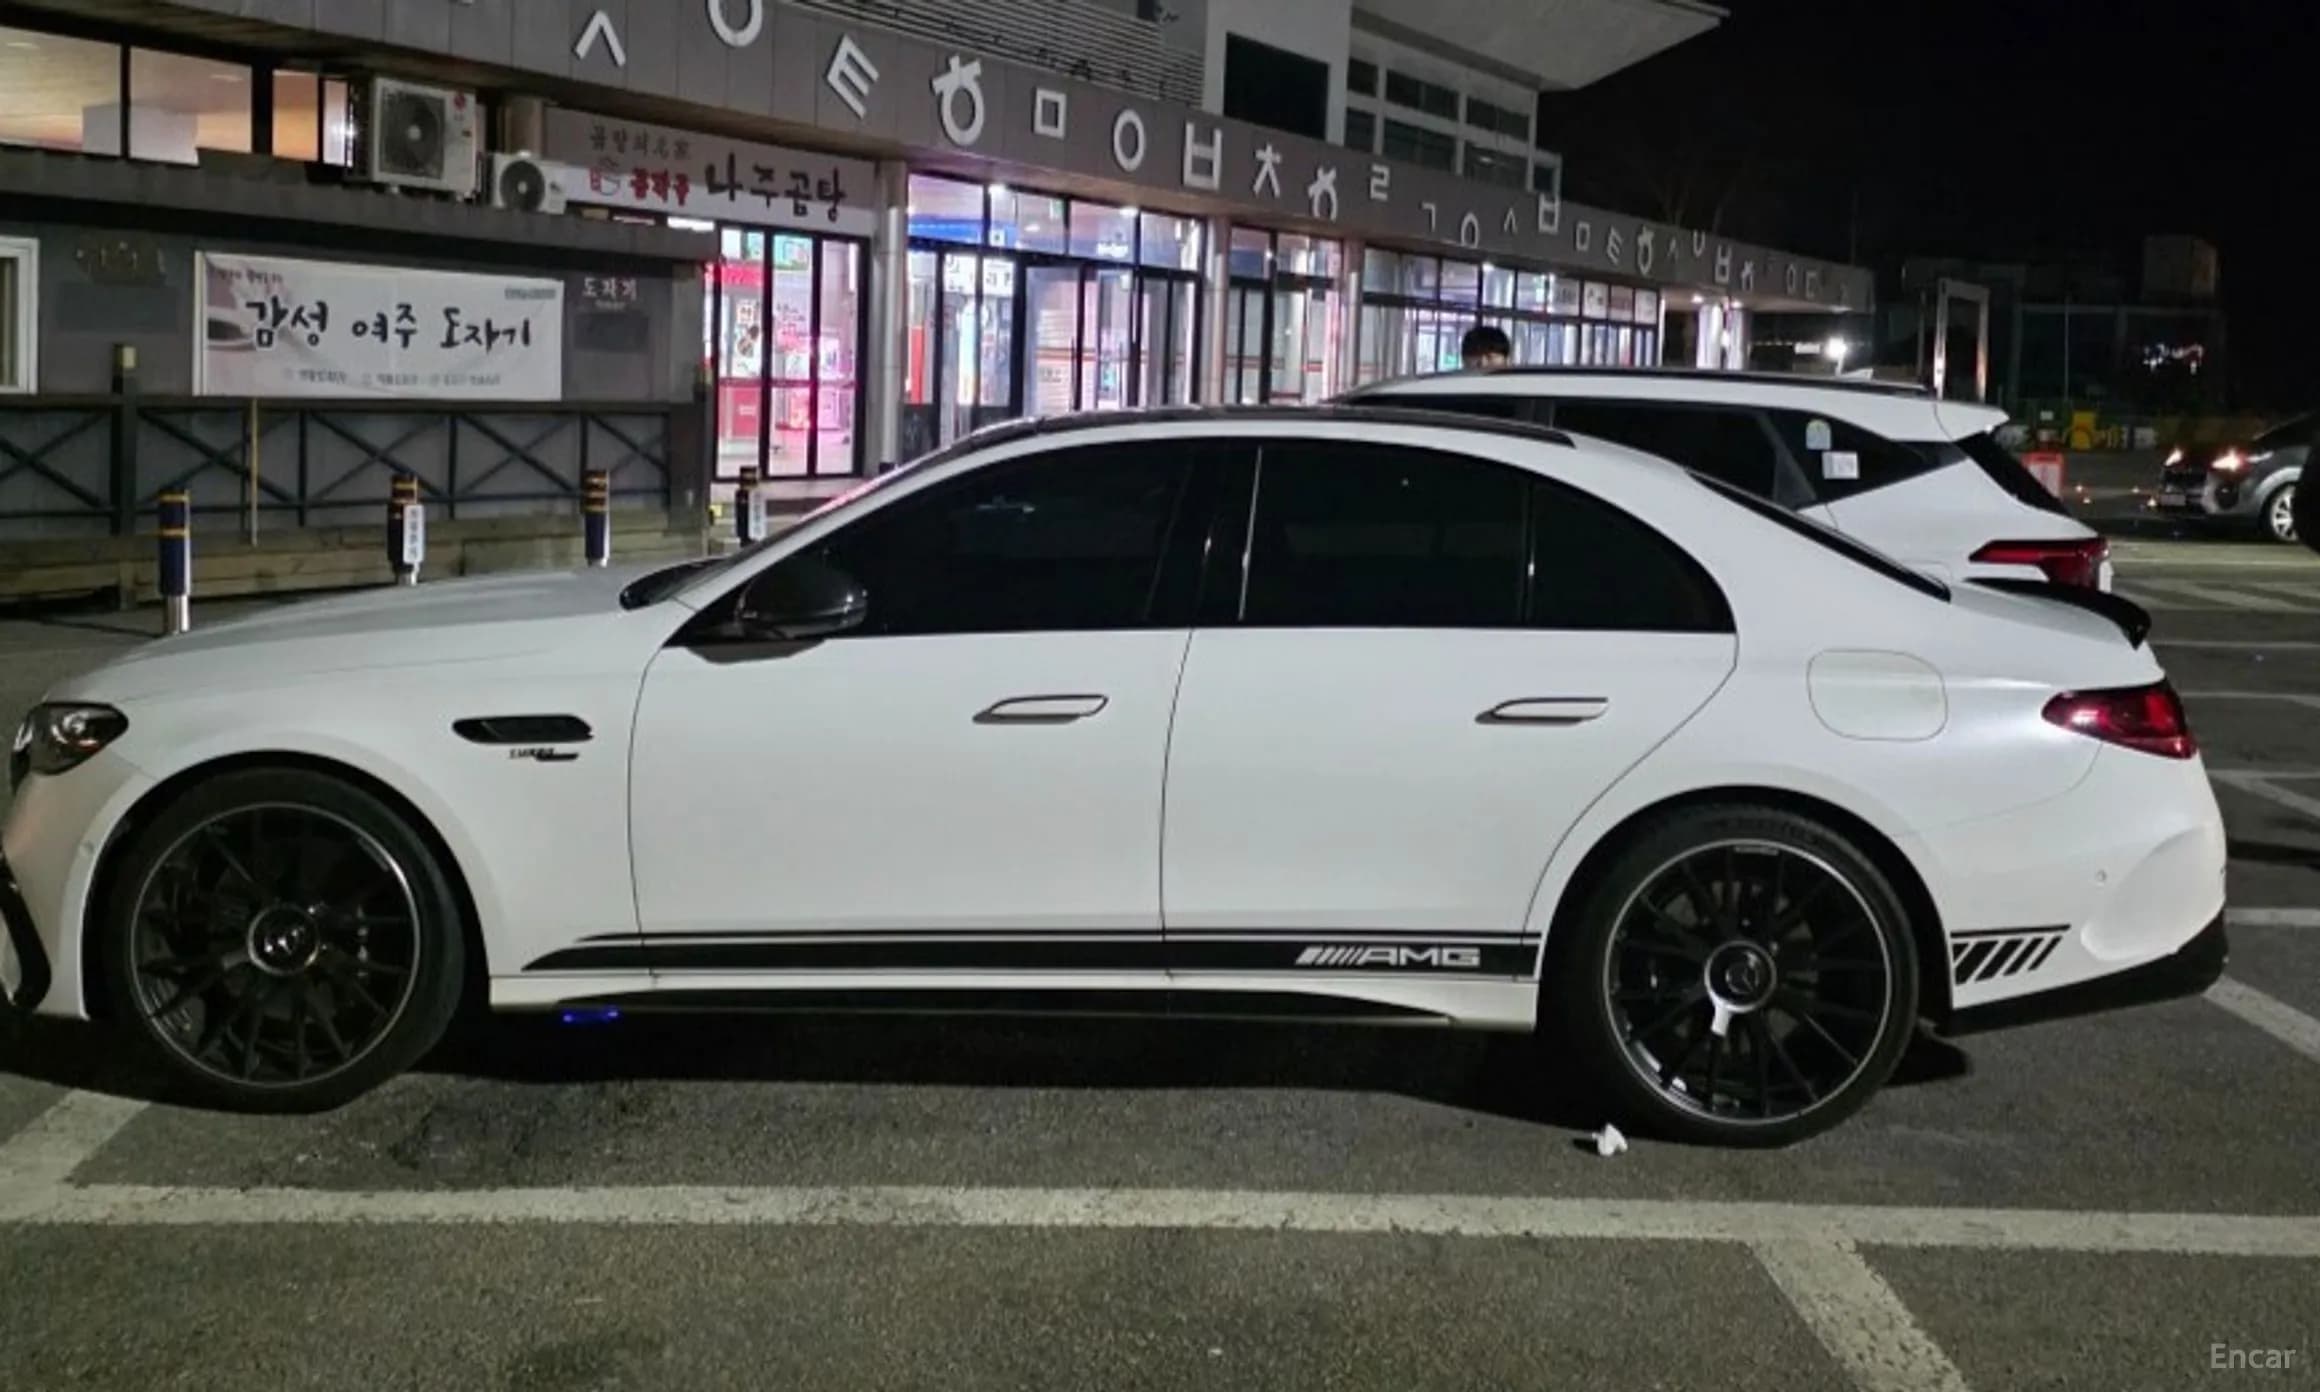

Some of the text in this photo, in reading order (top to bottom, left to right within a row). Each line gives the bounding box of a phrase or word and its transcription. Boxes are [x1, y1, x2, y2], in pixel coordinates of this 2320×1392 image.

[705, 152, 848, 223] 나주곰탕
[246, 295, 531, 354] 감성 여주 도자기
